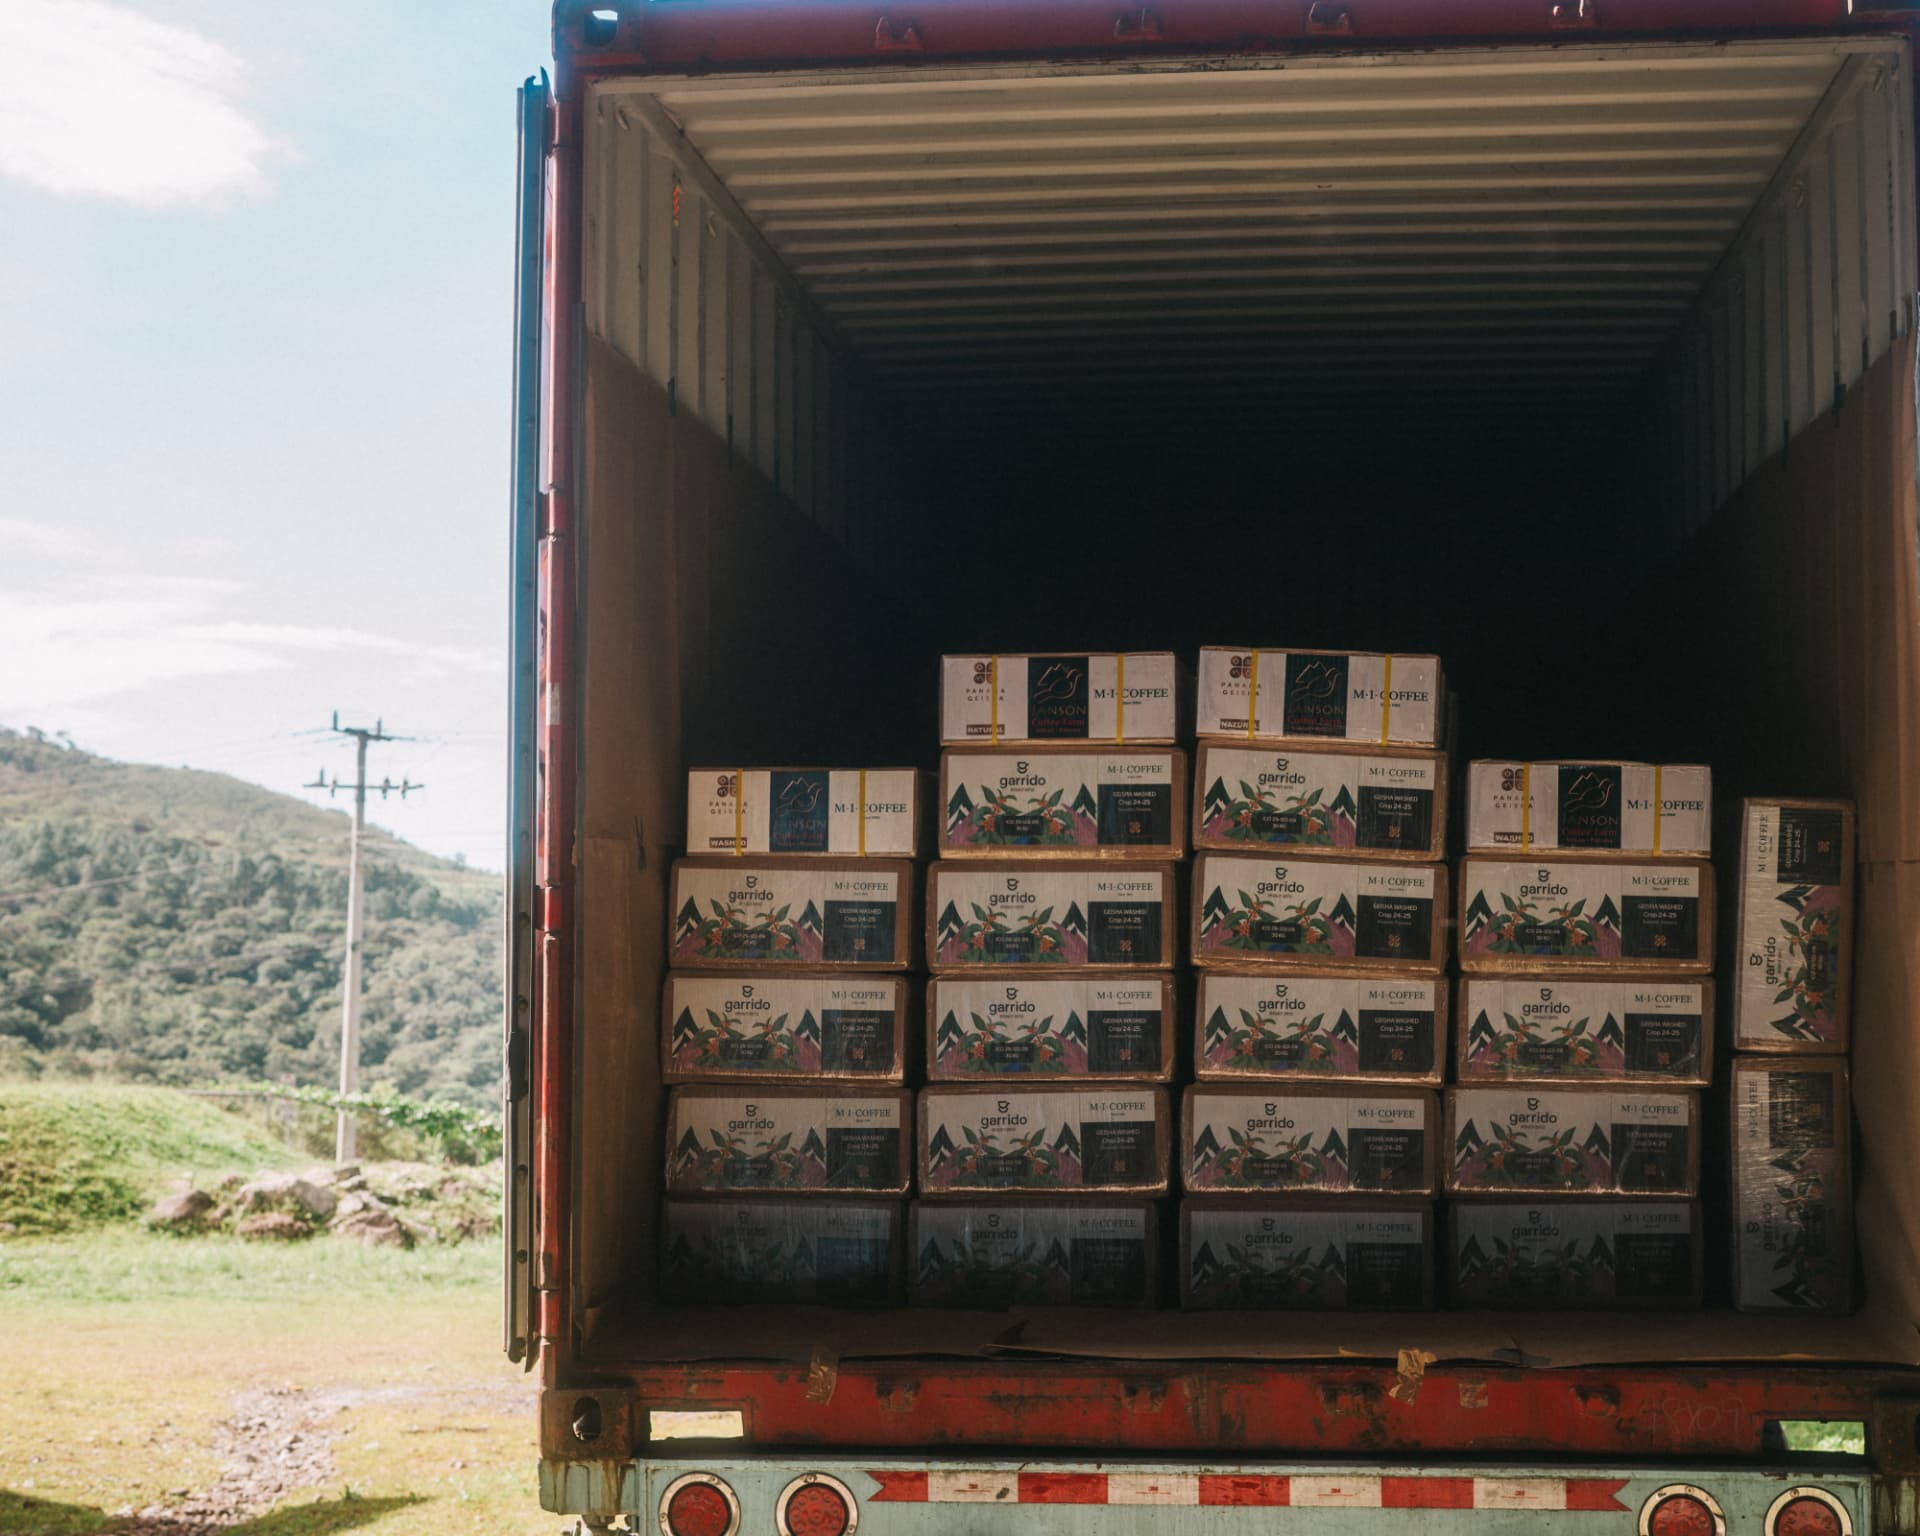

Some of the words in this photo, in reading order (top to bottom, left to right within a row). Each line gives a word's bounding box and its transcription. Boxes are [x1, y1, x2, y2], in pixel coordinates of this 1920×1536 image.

[1000, 775, 1045, 788] garrido
[1259, 772, 1305, 785] garrido
[1258, 881, 1304, 895] garrido
[1520, 883, 1567, 896] garrido
[729, 888, 773, 903] garrido
[990, 892, 1035, 905] garrido
[1764, 936, 1777, 985] garrido
[725, 999, 770, 1013] garrido
[989, 1001, 1035, 1014] garrido
[1259, 998, 1305, 1012] garrido
[1523, 1002, 1570, 1014] garrido
[729, 1119, 774, 1131] garrido
[981, 1114, 1027, 1129] garrido
[1247, 1117, 1294, 1130] garrido
[1510, 1112, 1557, 1126] garrido
[972, 1229, 1017, 1242] garrido
[1512, 1225, 1559, 1240] garrido
[1245, 1232, 1292, 1247] garrido
